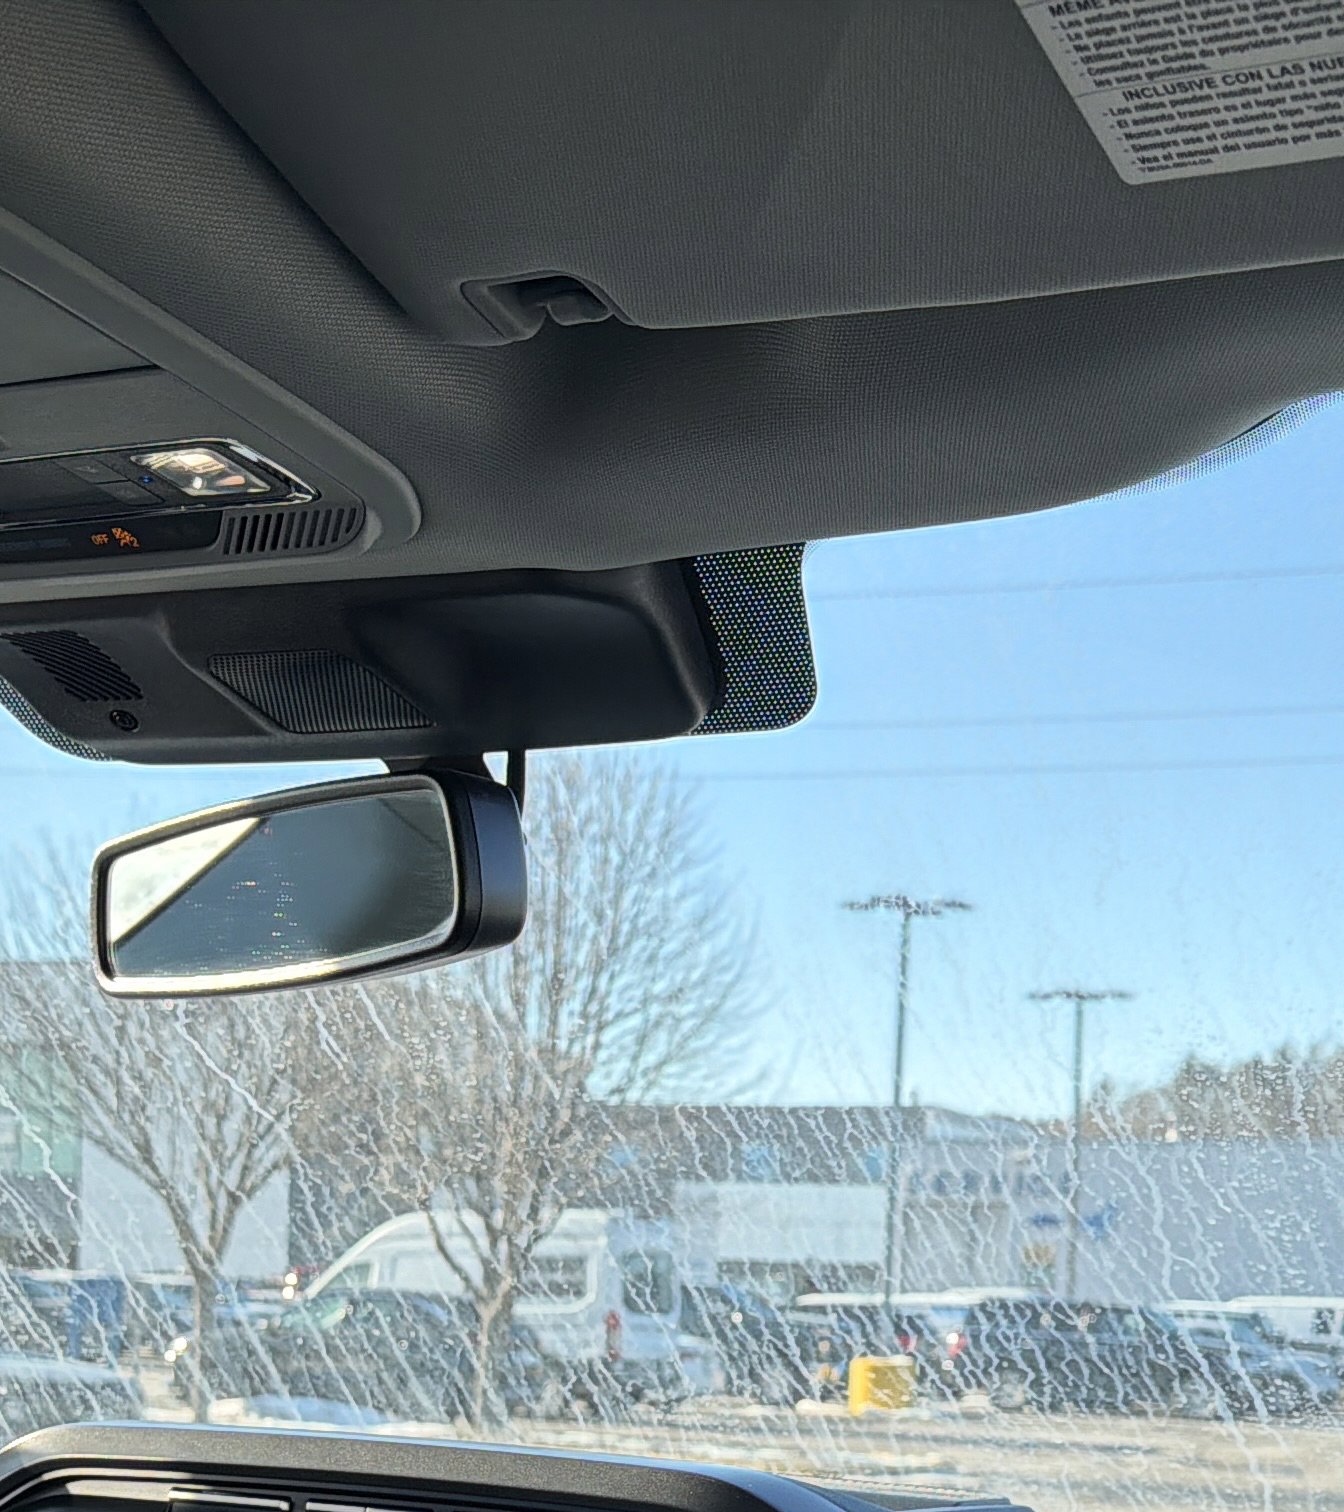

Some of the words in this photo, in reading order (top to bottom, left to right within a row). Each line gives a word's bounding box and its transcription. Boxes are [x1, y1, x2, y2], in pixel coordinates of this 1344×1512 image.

[1122, 77, 1220, 101] INCLUSIVE
[1222, 68, 1264, 86] CON
[1266, 62, 1306, 79] LAS
